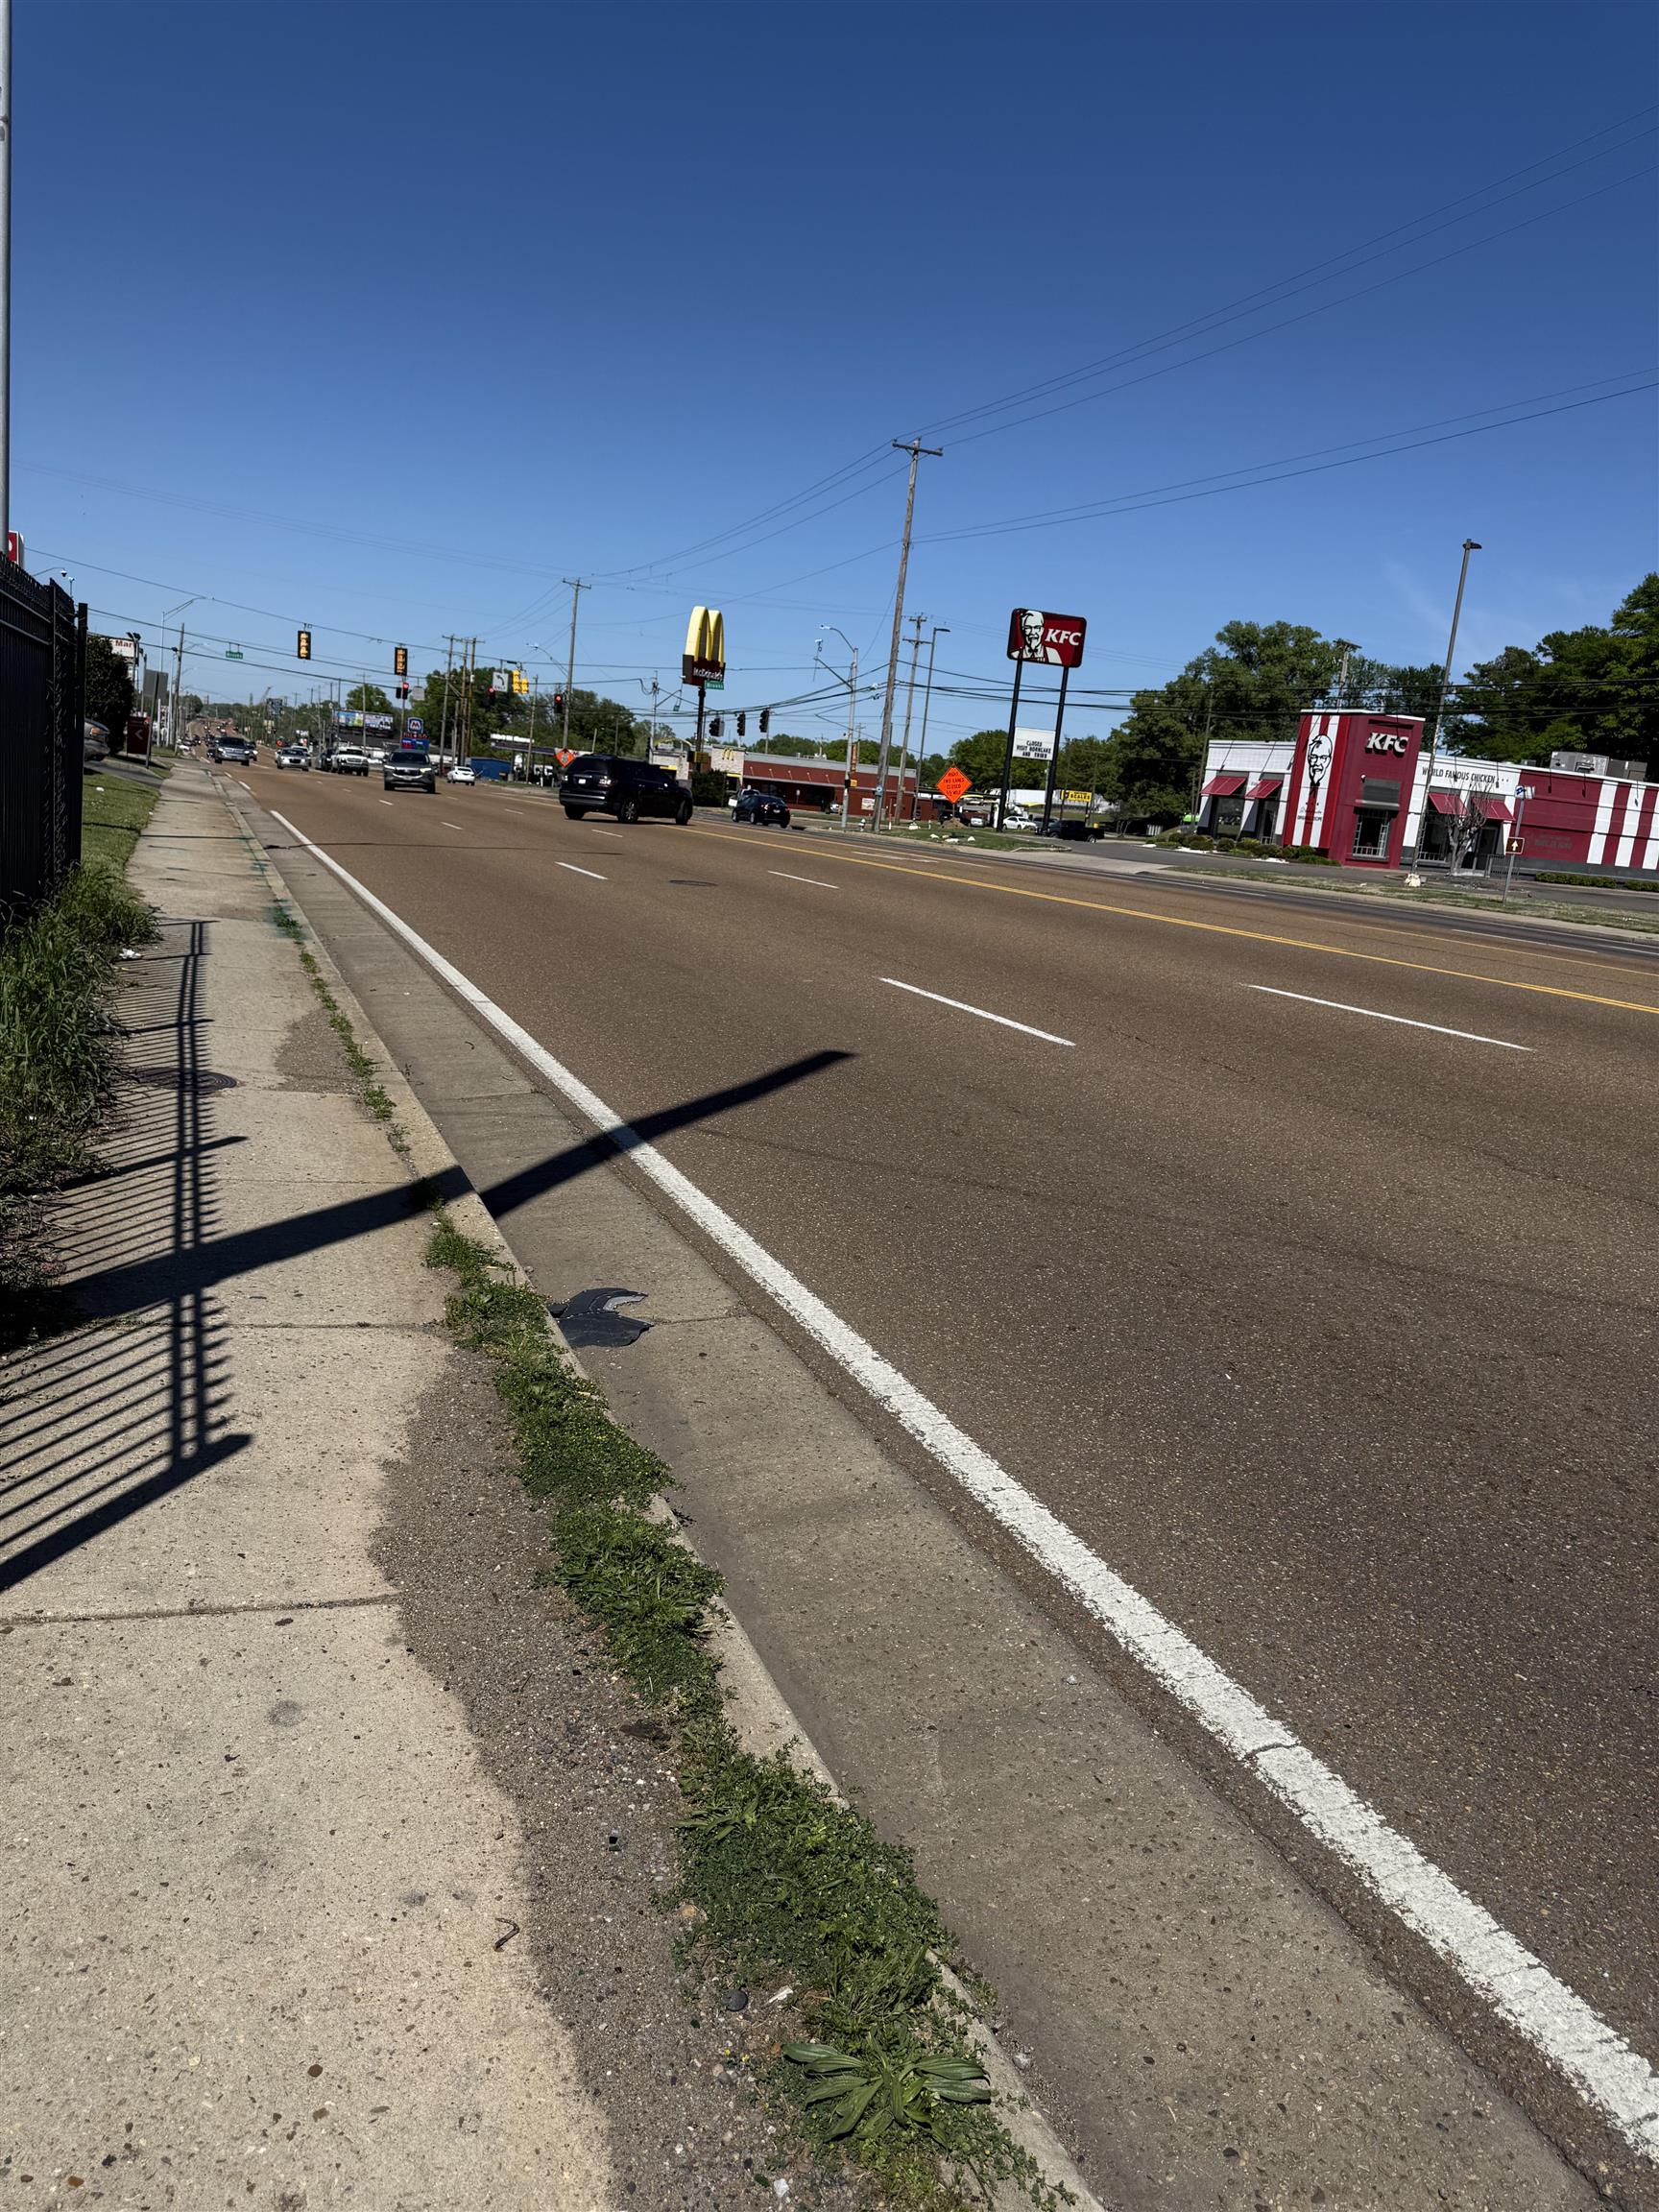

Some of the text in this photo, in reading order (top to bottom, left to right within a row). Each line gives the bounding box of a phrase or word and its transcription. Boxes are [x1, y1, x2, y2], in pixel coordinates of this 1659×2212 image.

[1045, 628, 1082, 646] KFC
[693, 667, 723, 680] McDonald's
[1366, 732, 1409, 753] KFC
[1422, 766, 1444, 778] WRLD
[1471, 772, 1496, 784] CHICKEN
